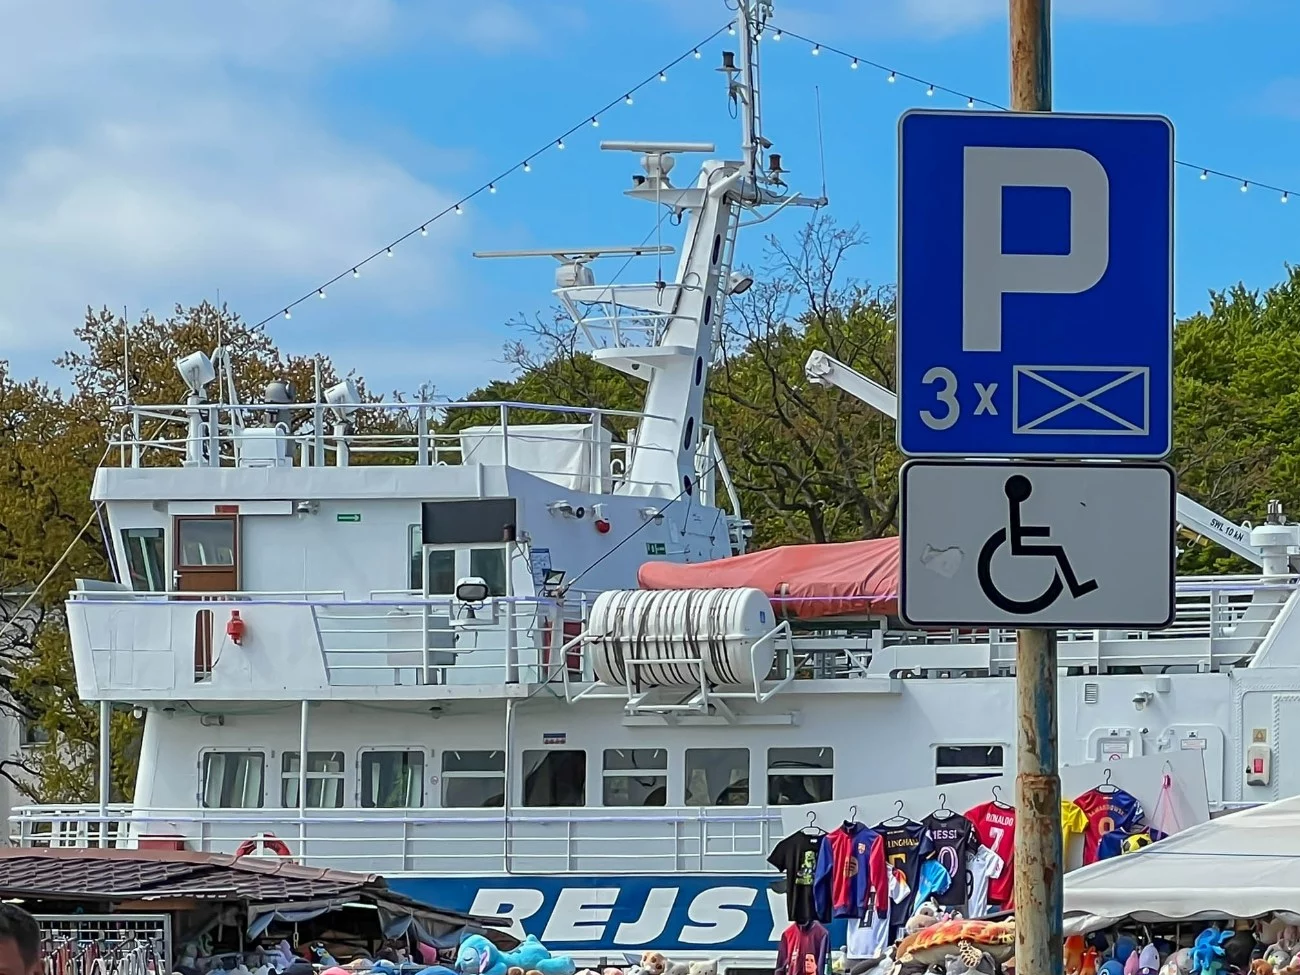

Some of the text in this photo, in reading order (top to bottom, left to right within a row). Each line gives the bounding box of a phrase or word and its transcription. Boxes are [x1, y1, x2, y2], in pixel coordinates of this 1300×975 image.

[962, 146, 1109, 353] P
[919, 366, 961, 431] 3
[1209, 518, 1224, 532] SWL
[1225, 526, 1234, 536] 10
[985, 812, 1014, 827] RONALDO
